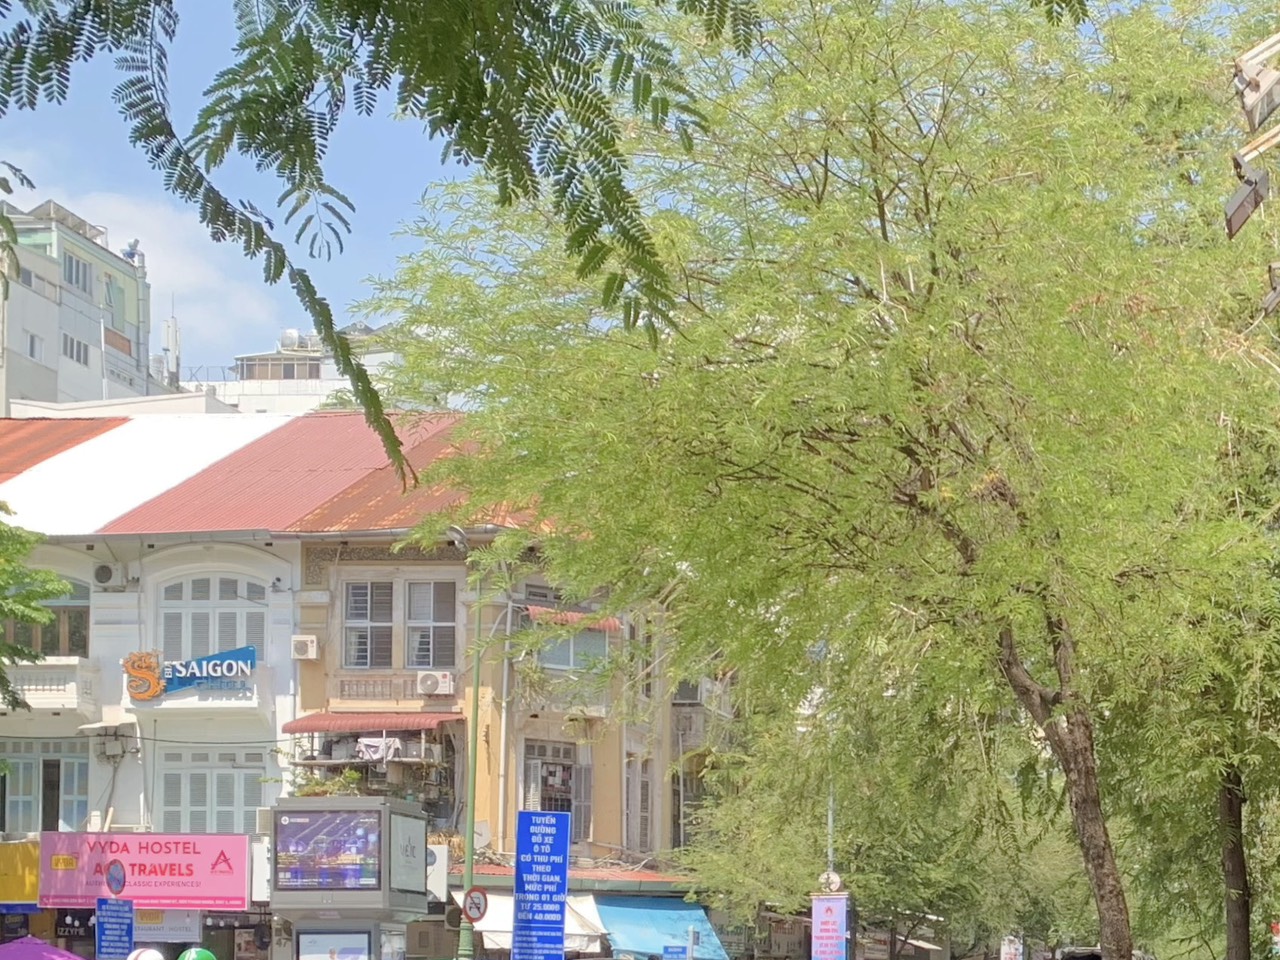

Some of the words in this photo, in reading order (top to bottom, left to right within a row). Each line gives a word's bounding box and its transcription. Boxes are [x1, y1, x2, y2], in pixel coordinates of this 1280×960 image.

[175, 660, 251, 677] SAIGON
[86, 841, 130, 854] VYDA
[138, 841, 201, 855] HOSTEL
[129, 863, 194, 877] TRAVELS
[532, 864, 552, 873] THEO
